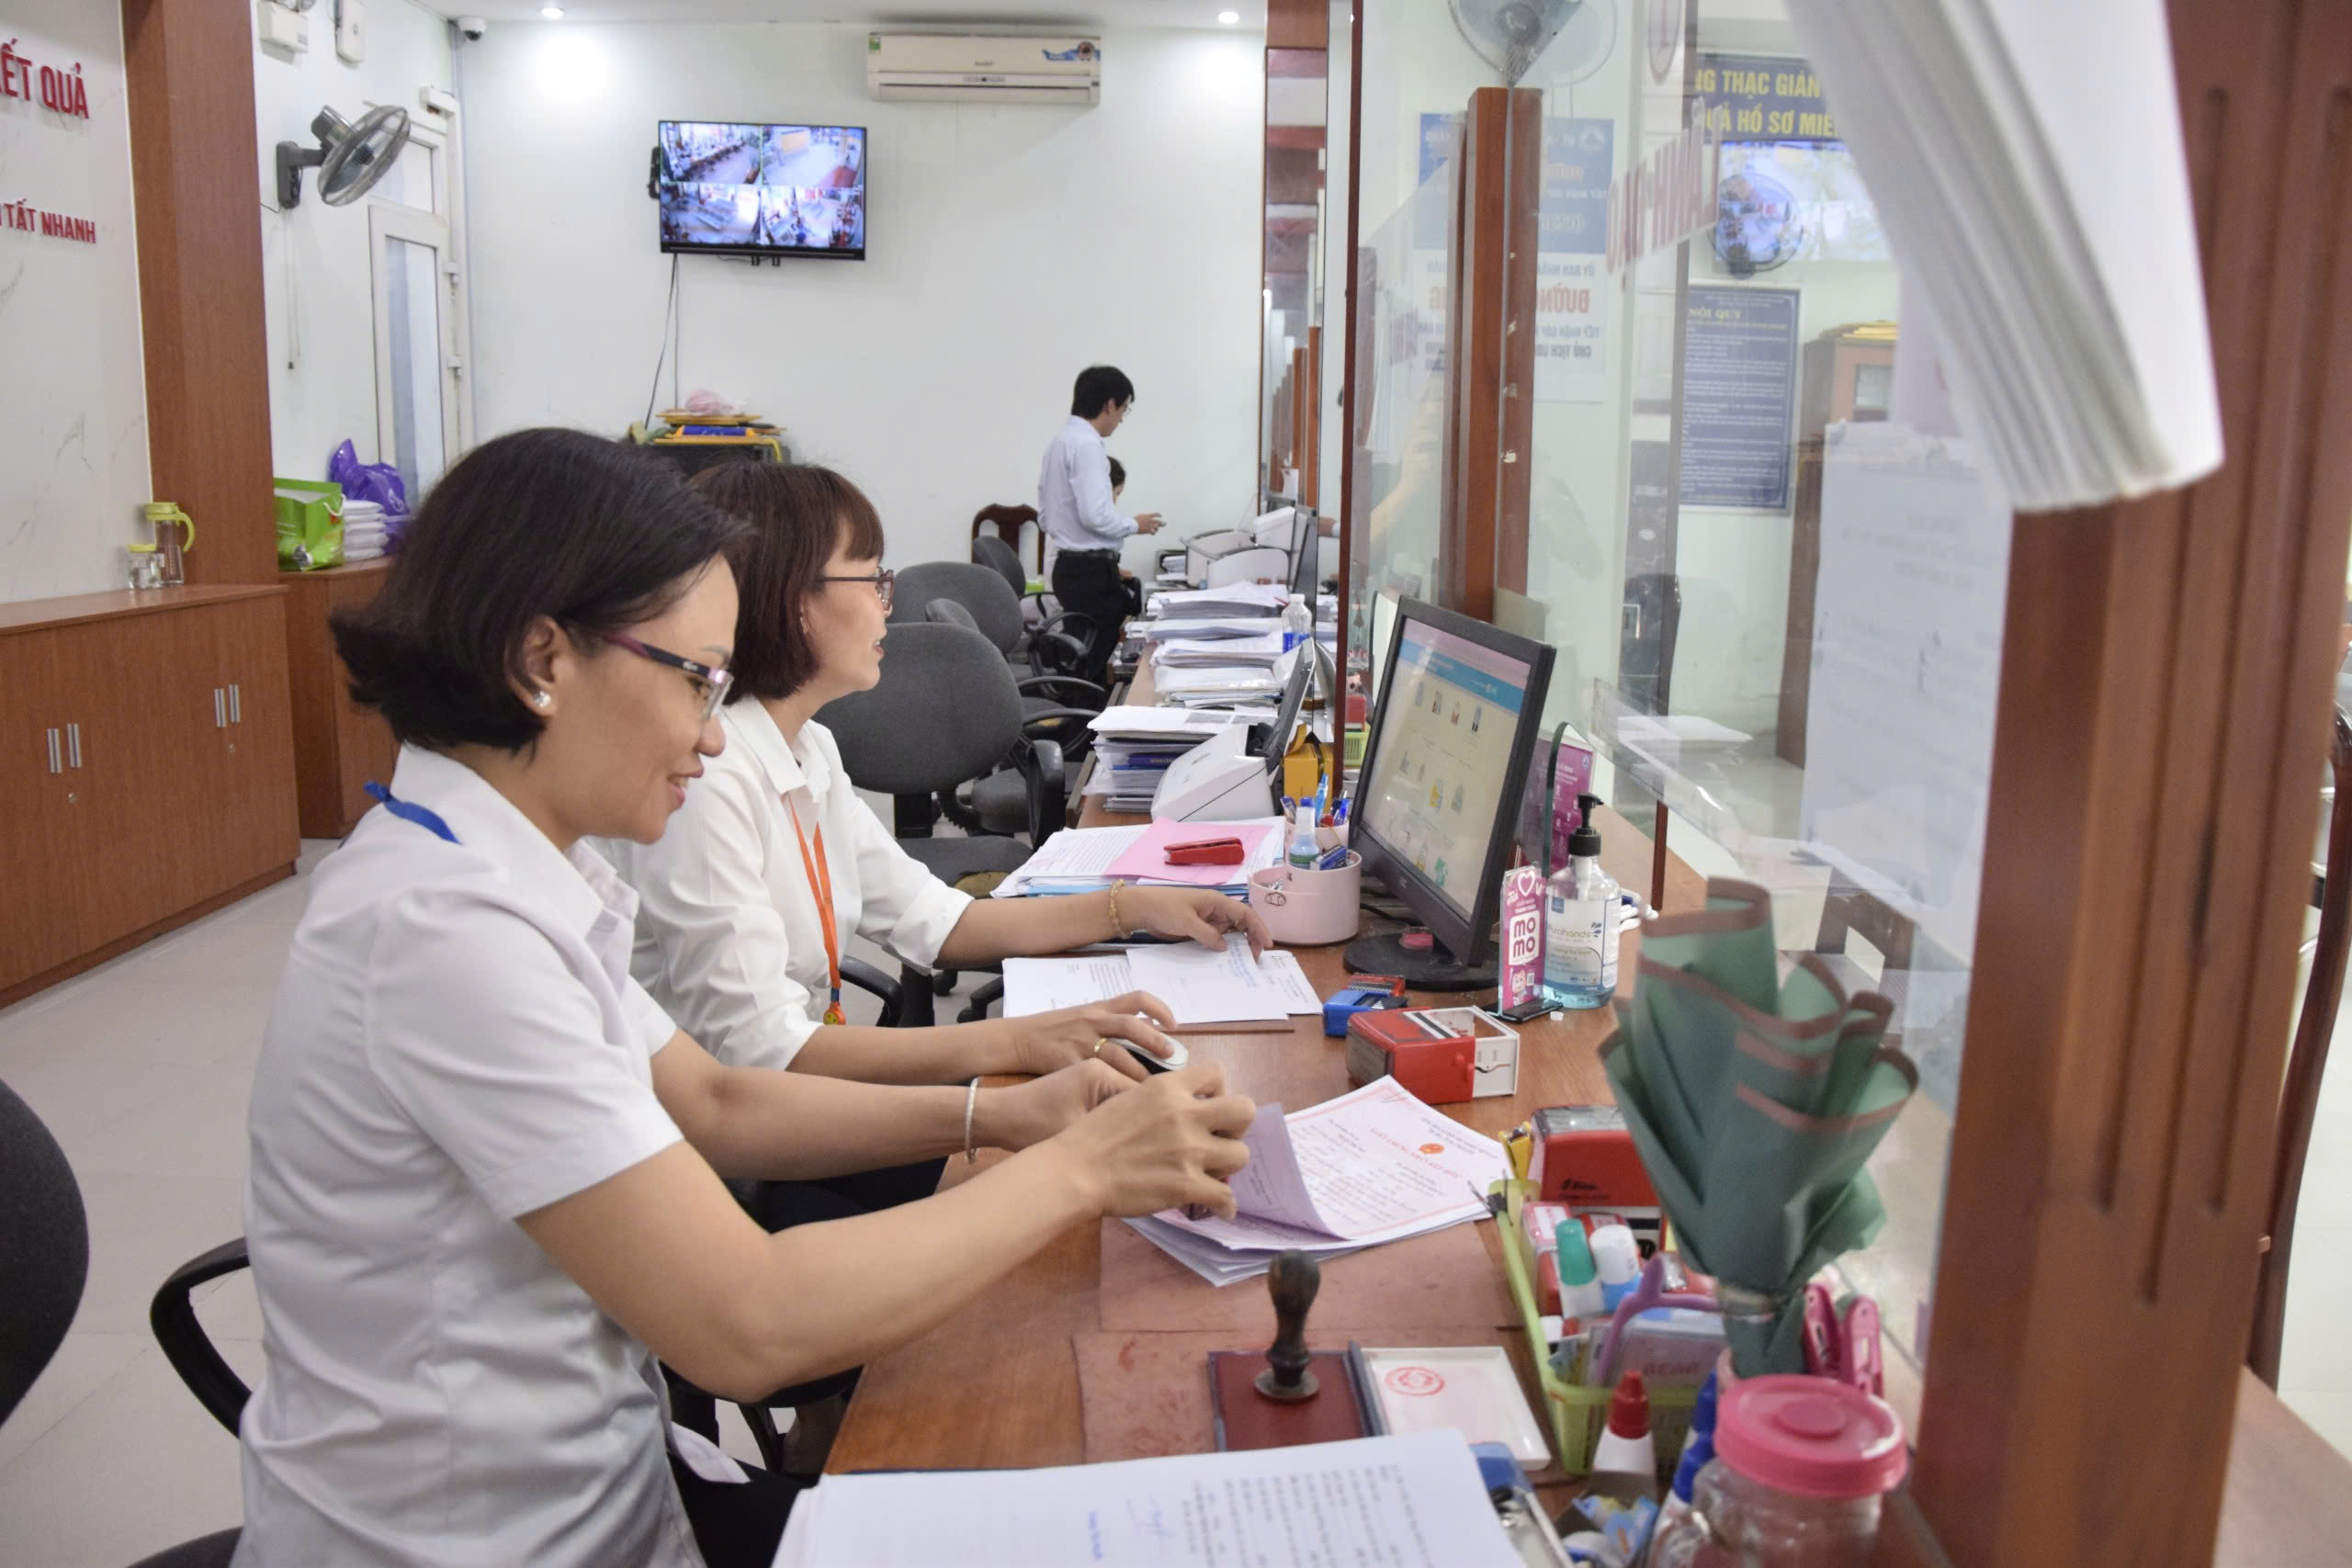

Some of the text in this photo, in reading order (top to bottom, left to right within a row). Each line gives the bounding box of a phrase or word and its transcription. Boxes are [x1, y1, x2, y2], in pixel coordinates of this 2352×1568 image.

[0, 38, 89, 118] ẾT QUẢ
[1723, 71, 1770, 100] THẠC
[40, 210, 96, 244] NHANH
[1513, 916, 1536, 938] mo
[1512, 935, 1536, 958] mo
